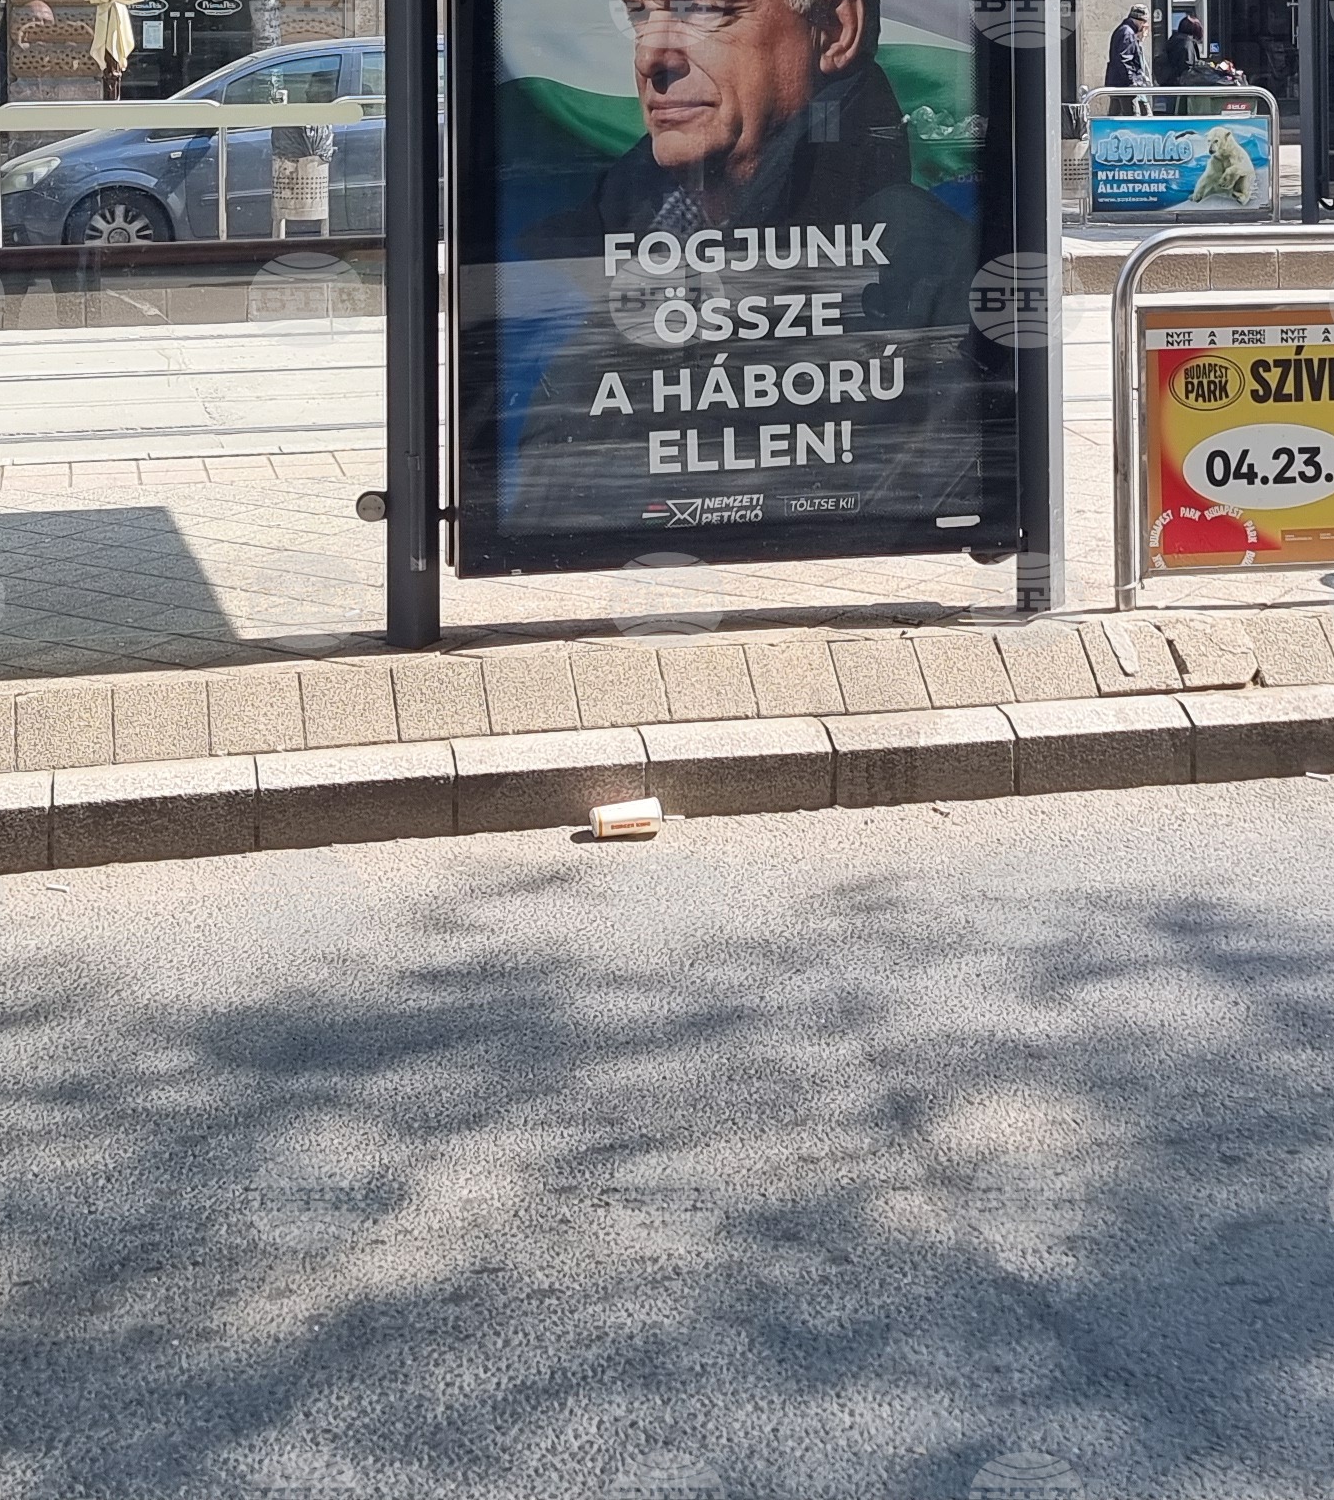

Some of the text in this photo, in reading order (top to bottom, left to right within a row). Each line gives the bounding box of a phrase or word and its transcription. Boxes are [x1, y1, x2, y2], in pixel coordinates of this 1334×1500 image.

[1096, 130, 1193, 165] JÉGVILÁG
[1097, 182, 1167, 194] ÁLLATPARK
[604, 222, 891, 277] FOGJUNK
[653, 286, 844, 343] ÖSSZE
[1166, 331, 1193, 339] NYIT
[1231, 329, 1266, 338] PARK!
[1280, 328, 1307, 336] NYIT
[1322, 327, 1331, 335] A
[589, 344, 905, 417] A HÁBORÚ
[1184, 363, 1231, 380] BUDAPEST
[1184, 380, 1230, 403] PARK
[649, 420, 853, 475] ELLEN!
[1205, 445, 1334, 488] 04.23.
[701, 507, 763, 526] PETÍCIÓ
[703, 494, 764, 510] NEMZETI
[789, 497, 836, 512] TÖLTSE
[1179, 506, 1202, 521] PARK
[1243, 520, 1258, 544] PARK
